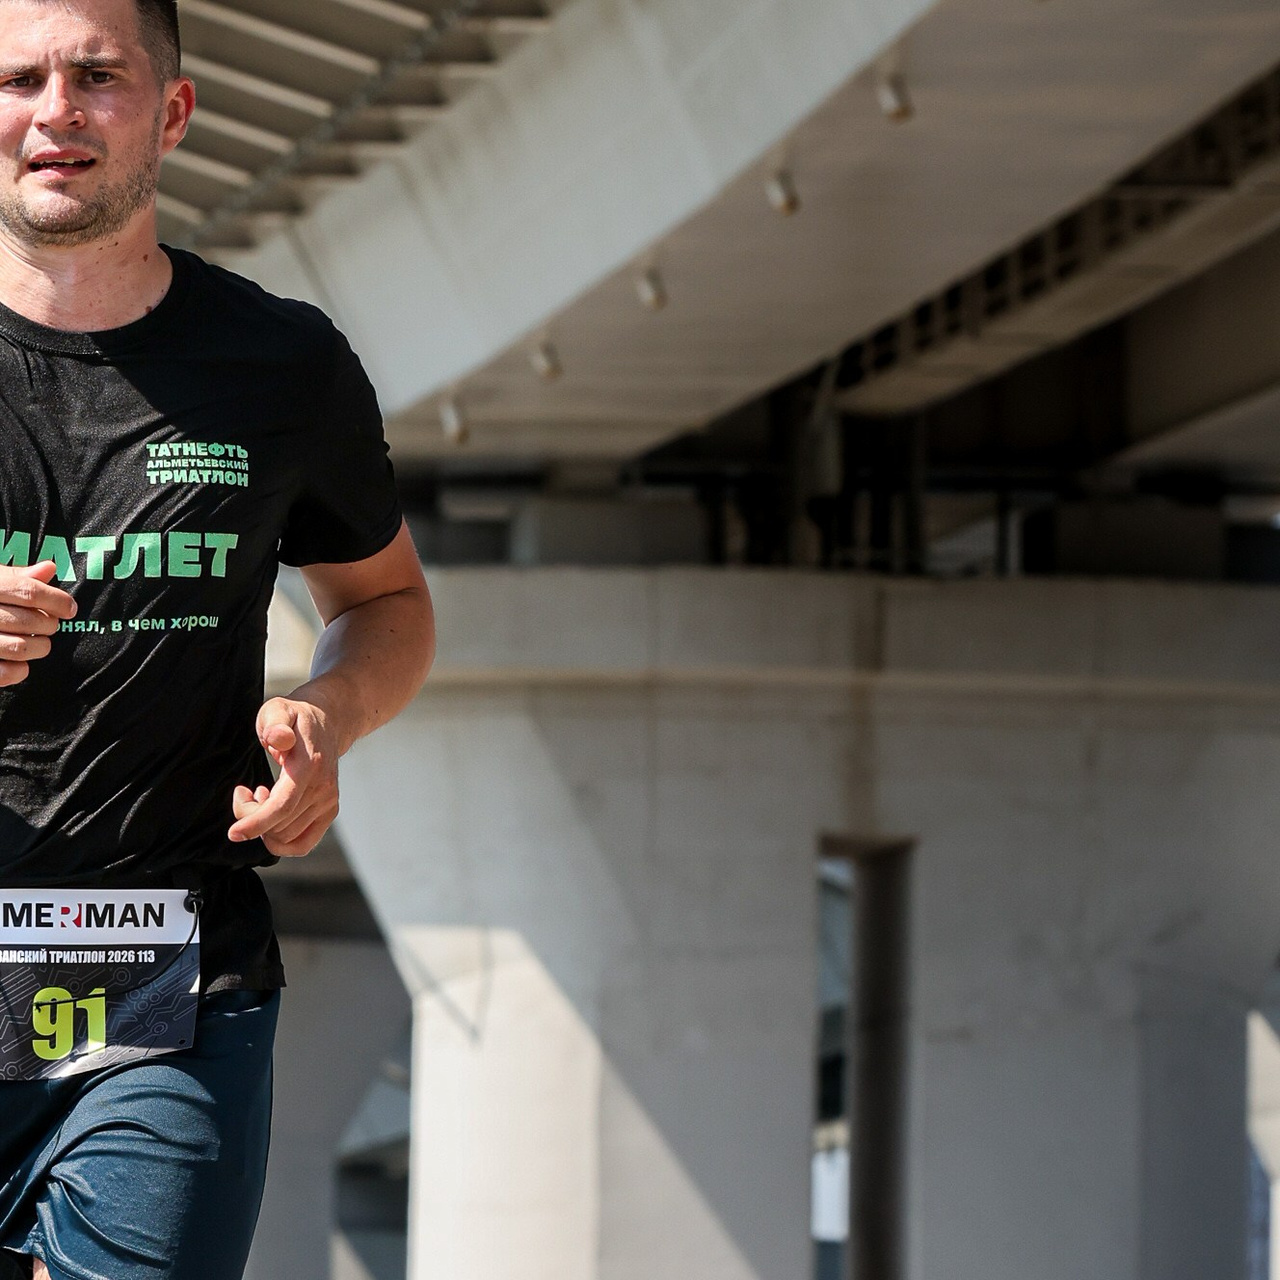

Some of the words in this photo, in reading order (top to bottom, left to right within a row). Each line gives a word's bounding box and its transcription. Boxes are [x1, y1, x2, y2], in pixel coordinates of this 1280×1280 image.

[146, 442, 249, 459] ТАТНЕФТЬ
[146, 458, 249, 471] АЛЬМЕТЬЕВСКИЙ
[146, 469, 249, 487] ТРИАТЛОН
[55, 620, 106, 635] нял,
[111, 620, 123, 632] в
[128, 618, 166, 631] чем
[170, 615, 219, 631] хорош
[49, 950, 106, 964] ТРИАТЛОН
[107, 949, 136, 963] 2026
[136, 949, 156, 963] 113
[32, 986, 107, 1061] 91
